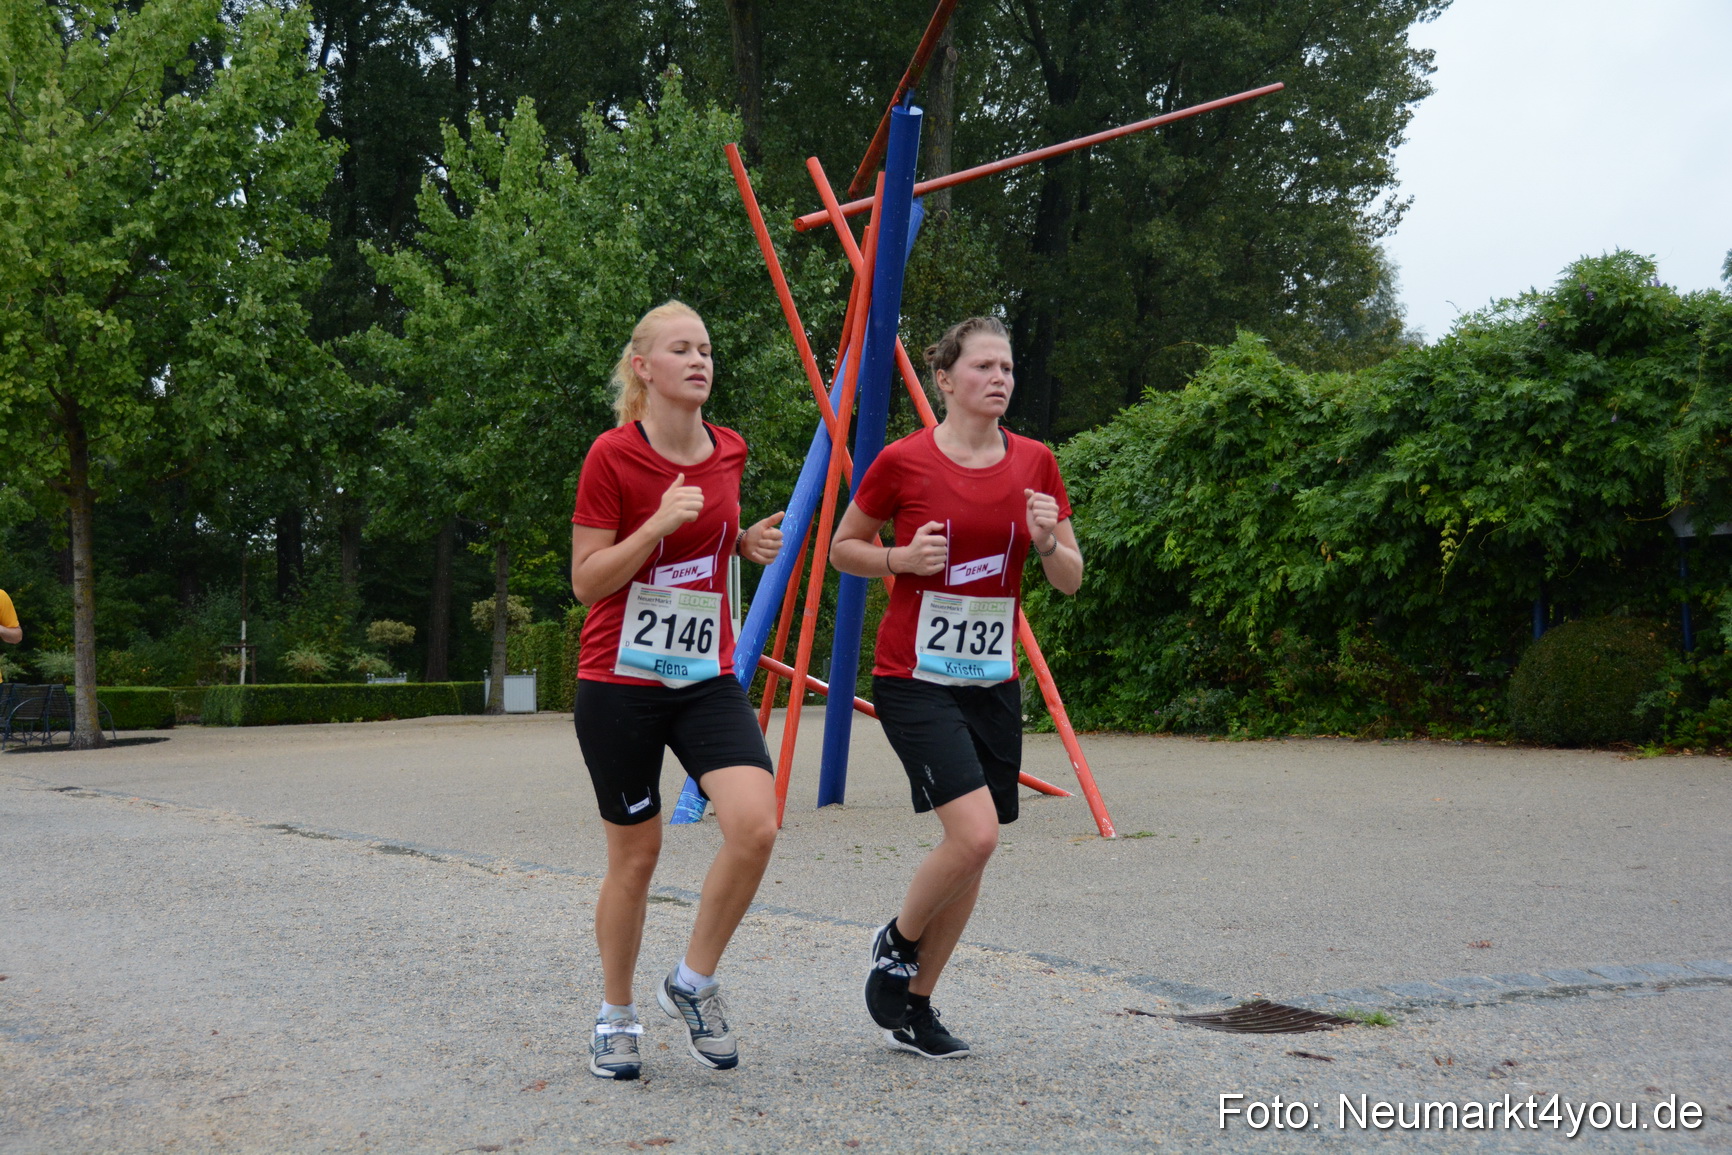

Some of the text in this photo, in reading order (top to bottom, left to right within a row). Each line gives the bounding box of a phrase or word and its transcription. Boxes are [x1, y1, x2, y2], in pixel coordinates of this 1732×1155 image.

[672, 566, 699, 579] DEHN
[965, 563, 989, 576] DEHN
[637, 595, 672, 605] NeuerMarkt
[678, 593, 718, 609] BOCK
[969, 600, 1007, 613] BOCK
[634, 609, 714, 654] 2146
[927, 617, 1004, 655] 2132
[654, 659, 688, 676] Elena
[945, 662, 985, 677] Kristin
